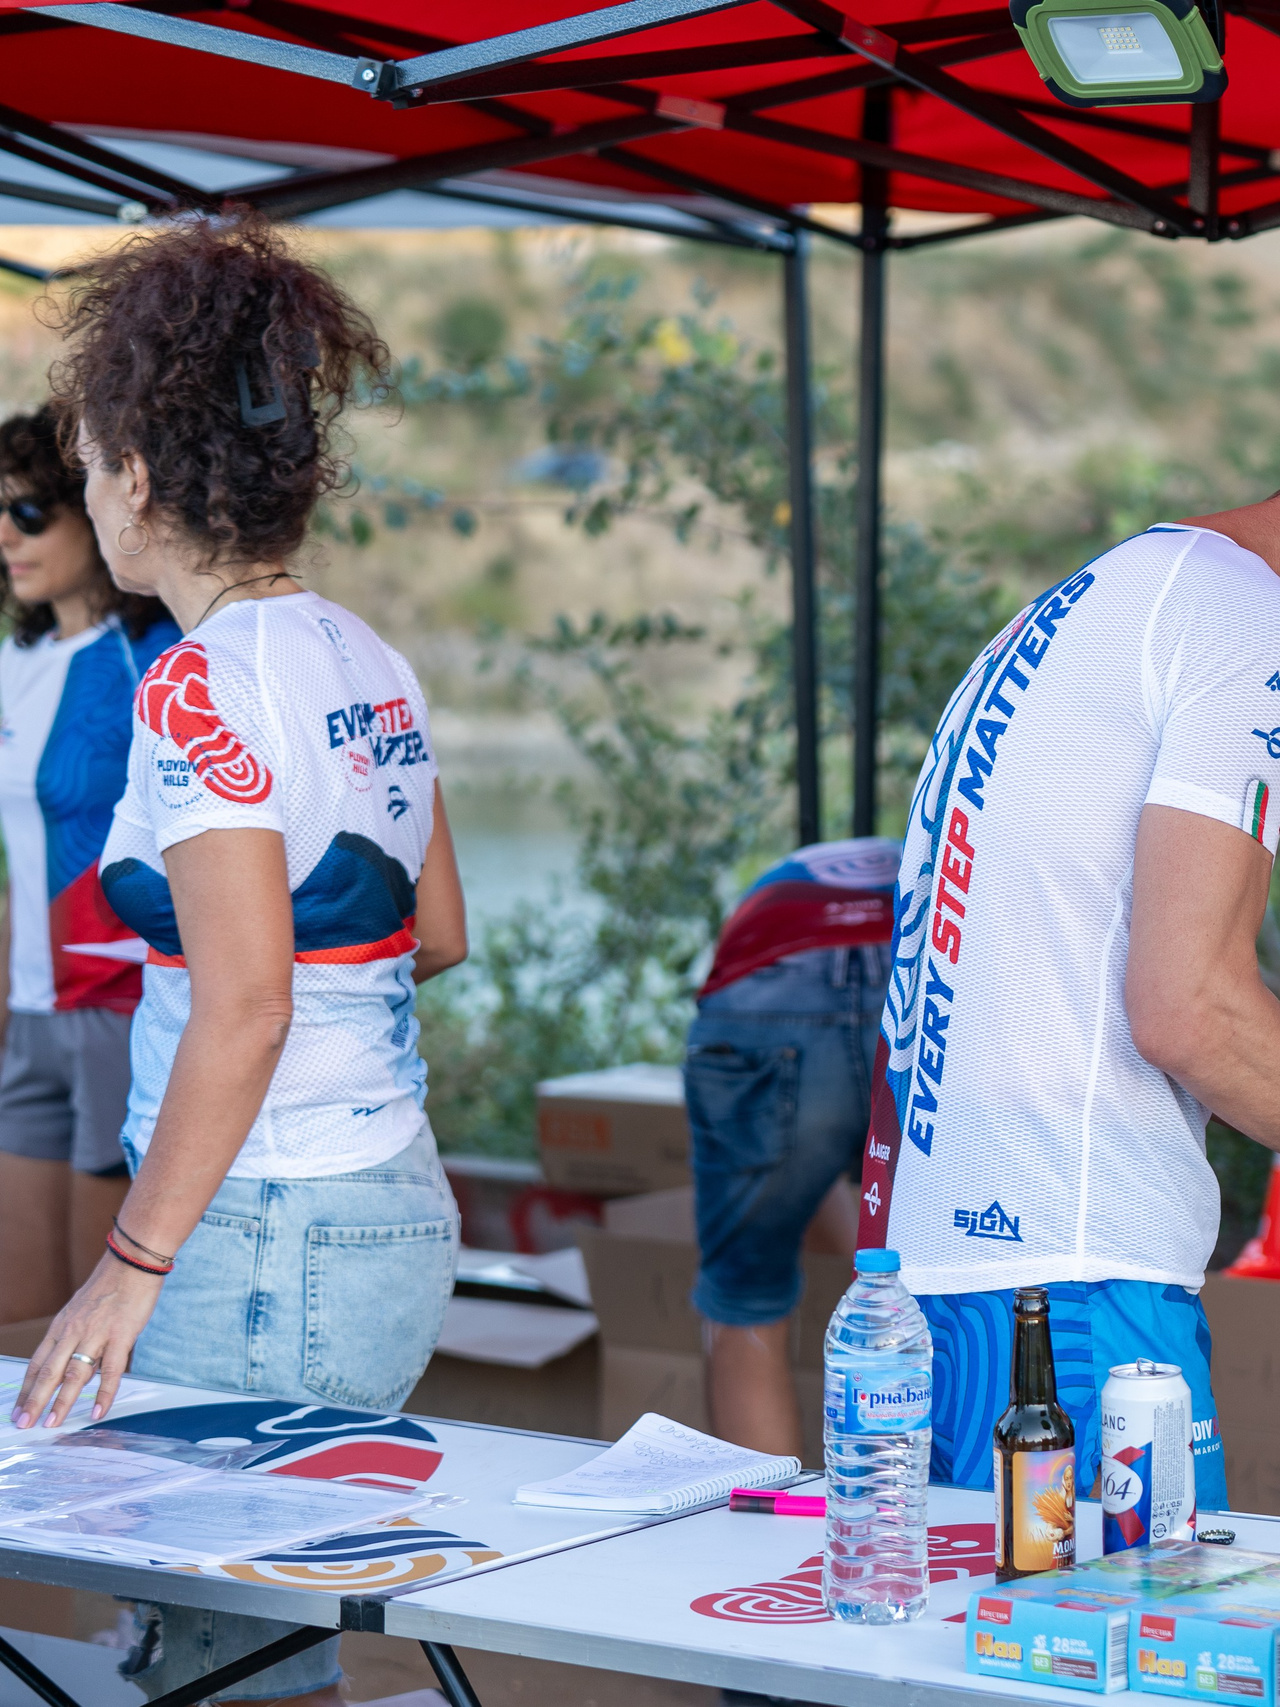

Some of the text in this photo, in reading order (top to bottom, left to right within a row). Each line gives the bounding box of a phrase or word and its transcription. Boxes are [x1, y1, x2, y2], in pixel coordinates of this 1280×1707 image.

[163, 775, 189, 787] HILLS
[907, 570, 1096, 1157] EVERY STEP MATTERS
[1101, 1414, 1126, 1431] LANC
[975, 1631, 1023, 1661] Ная
[1051, 1636, 1070, 1654] 28
[1138, 1649, 1188, 1678] Ная
[1217, 1653, 1236, 1670] 28
